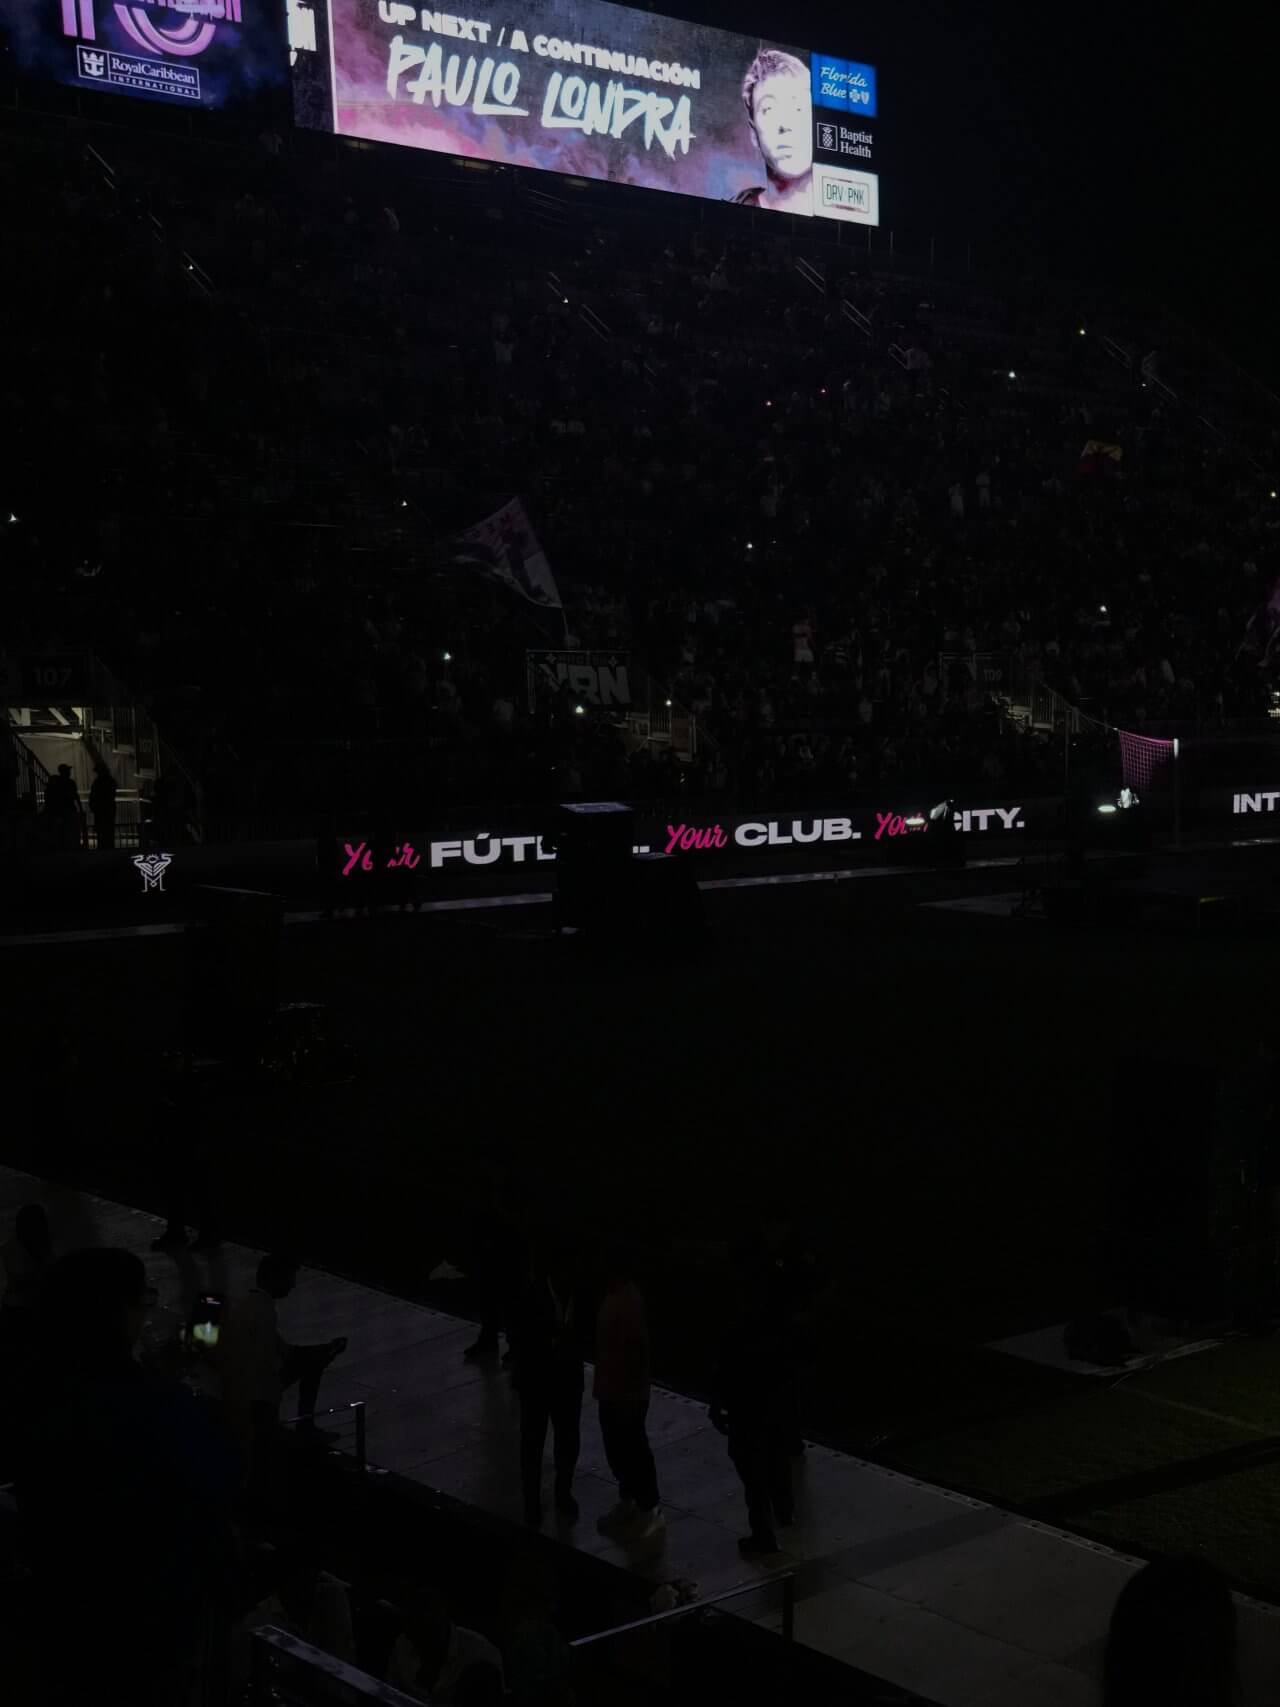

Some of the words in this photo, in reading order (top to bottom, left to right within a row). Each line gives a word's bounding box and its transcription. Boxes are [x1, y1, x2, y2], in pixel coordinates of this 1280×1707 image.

[378, 0, 416, 25] UP
[421, 9, 491, 43] NEXT
[510, 30, 529, 52] A
[533, 35, 700, 89] CONTINUACIÓN
[113, 75, 195, 96] INTERNATIONAL
[820, 66, 868, 88] Florida
[387, 35, 529, 117] PAULO
[541, 71, 696, 160] LONDRA
[820, 82, 847, 98] Blue
[839, 126, 873, 145] Baptist
[839, 141, 872, 159] Health
[826, 183, 843, 201] DRV
[848, 188, 865, 205] PNK
[665, 823, 728, 855] Your
[734, 817, 862, 847] CLUB.
[953, 807, 1025, 832] ITY.
